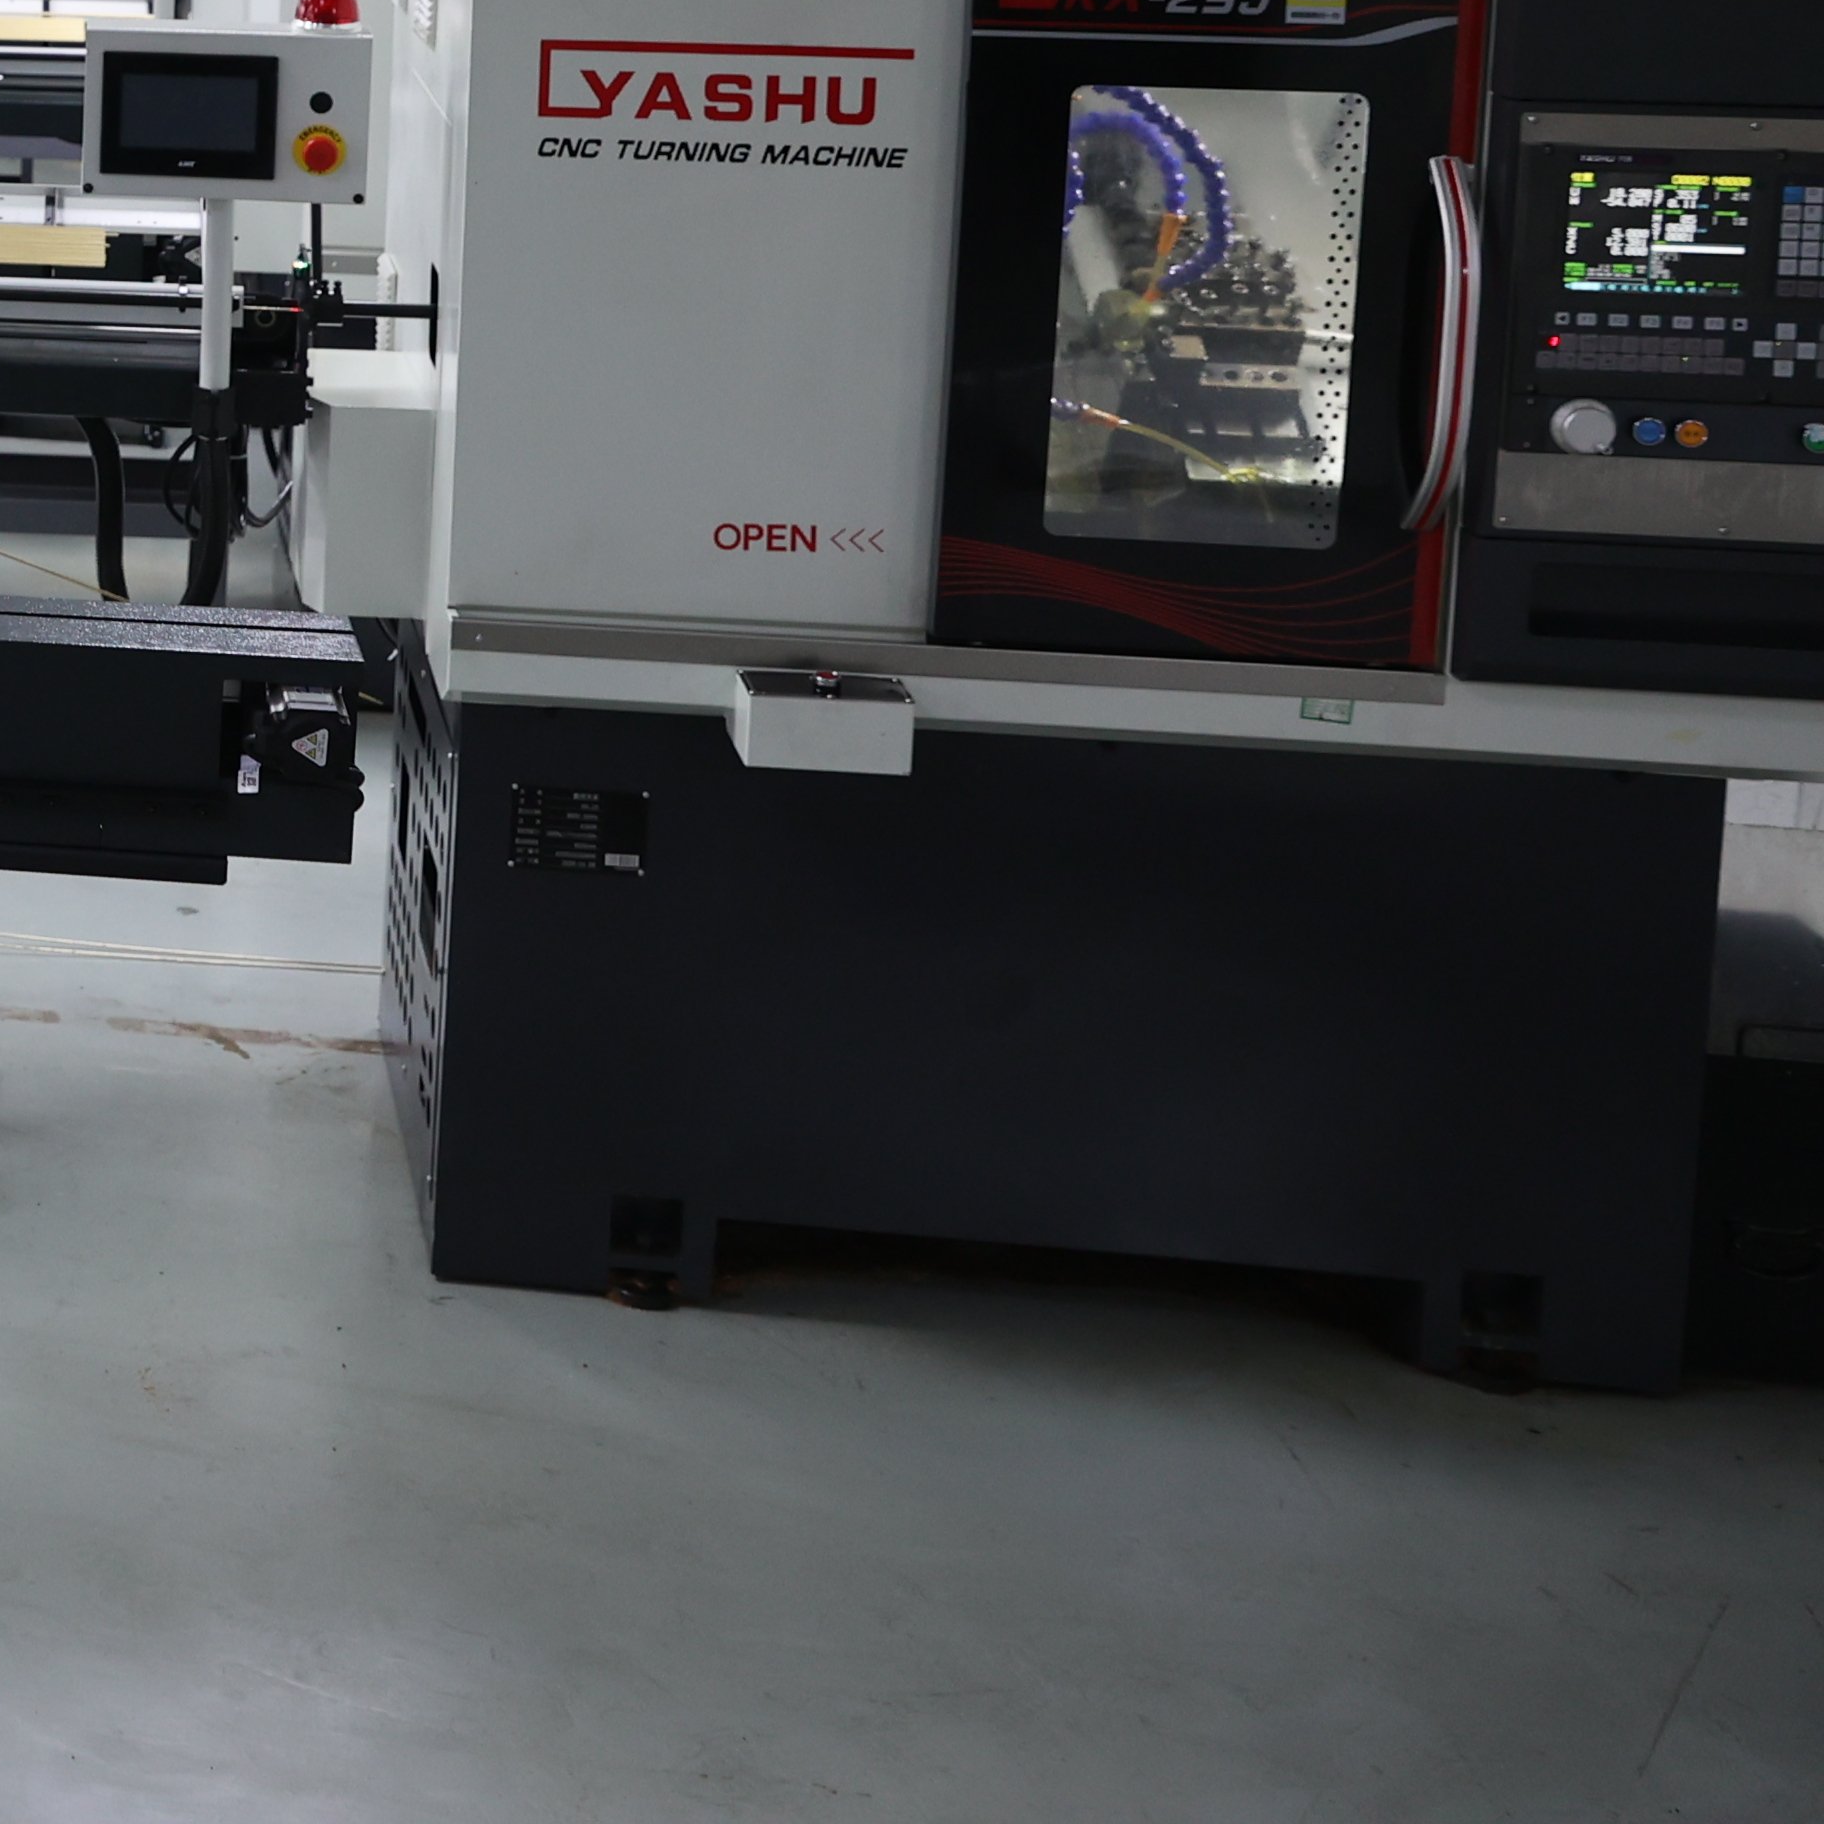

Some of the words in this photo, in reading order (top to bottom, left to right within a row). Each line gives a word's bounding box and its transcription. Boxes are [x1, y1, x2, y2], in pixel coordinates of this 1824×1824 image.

[578, 69, 878, 126] YASHU
[538, 137, 602, 159] CNC
[617, 140, 752, 164] TURNING
[761, 144, 909, 169] MACHINE
[713, 523, 817, 553] OPEN
